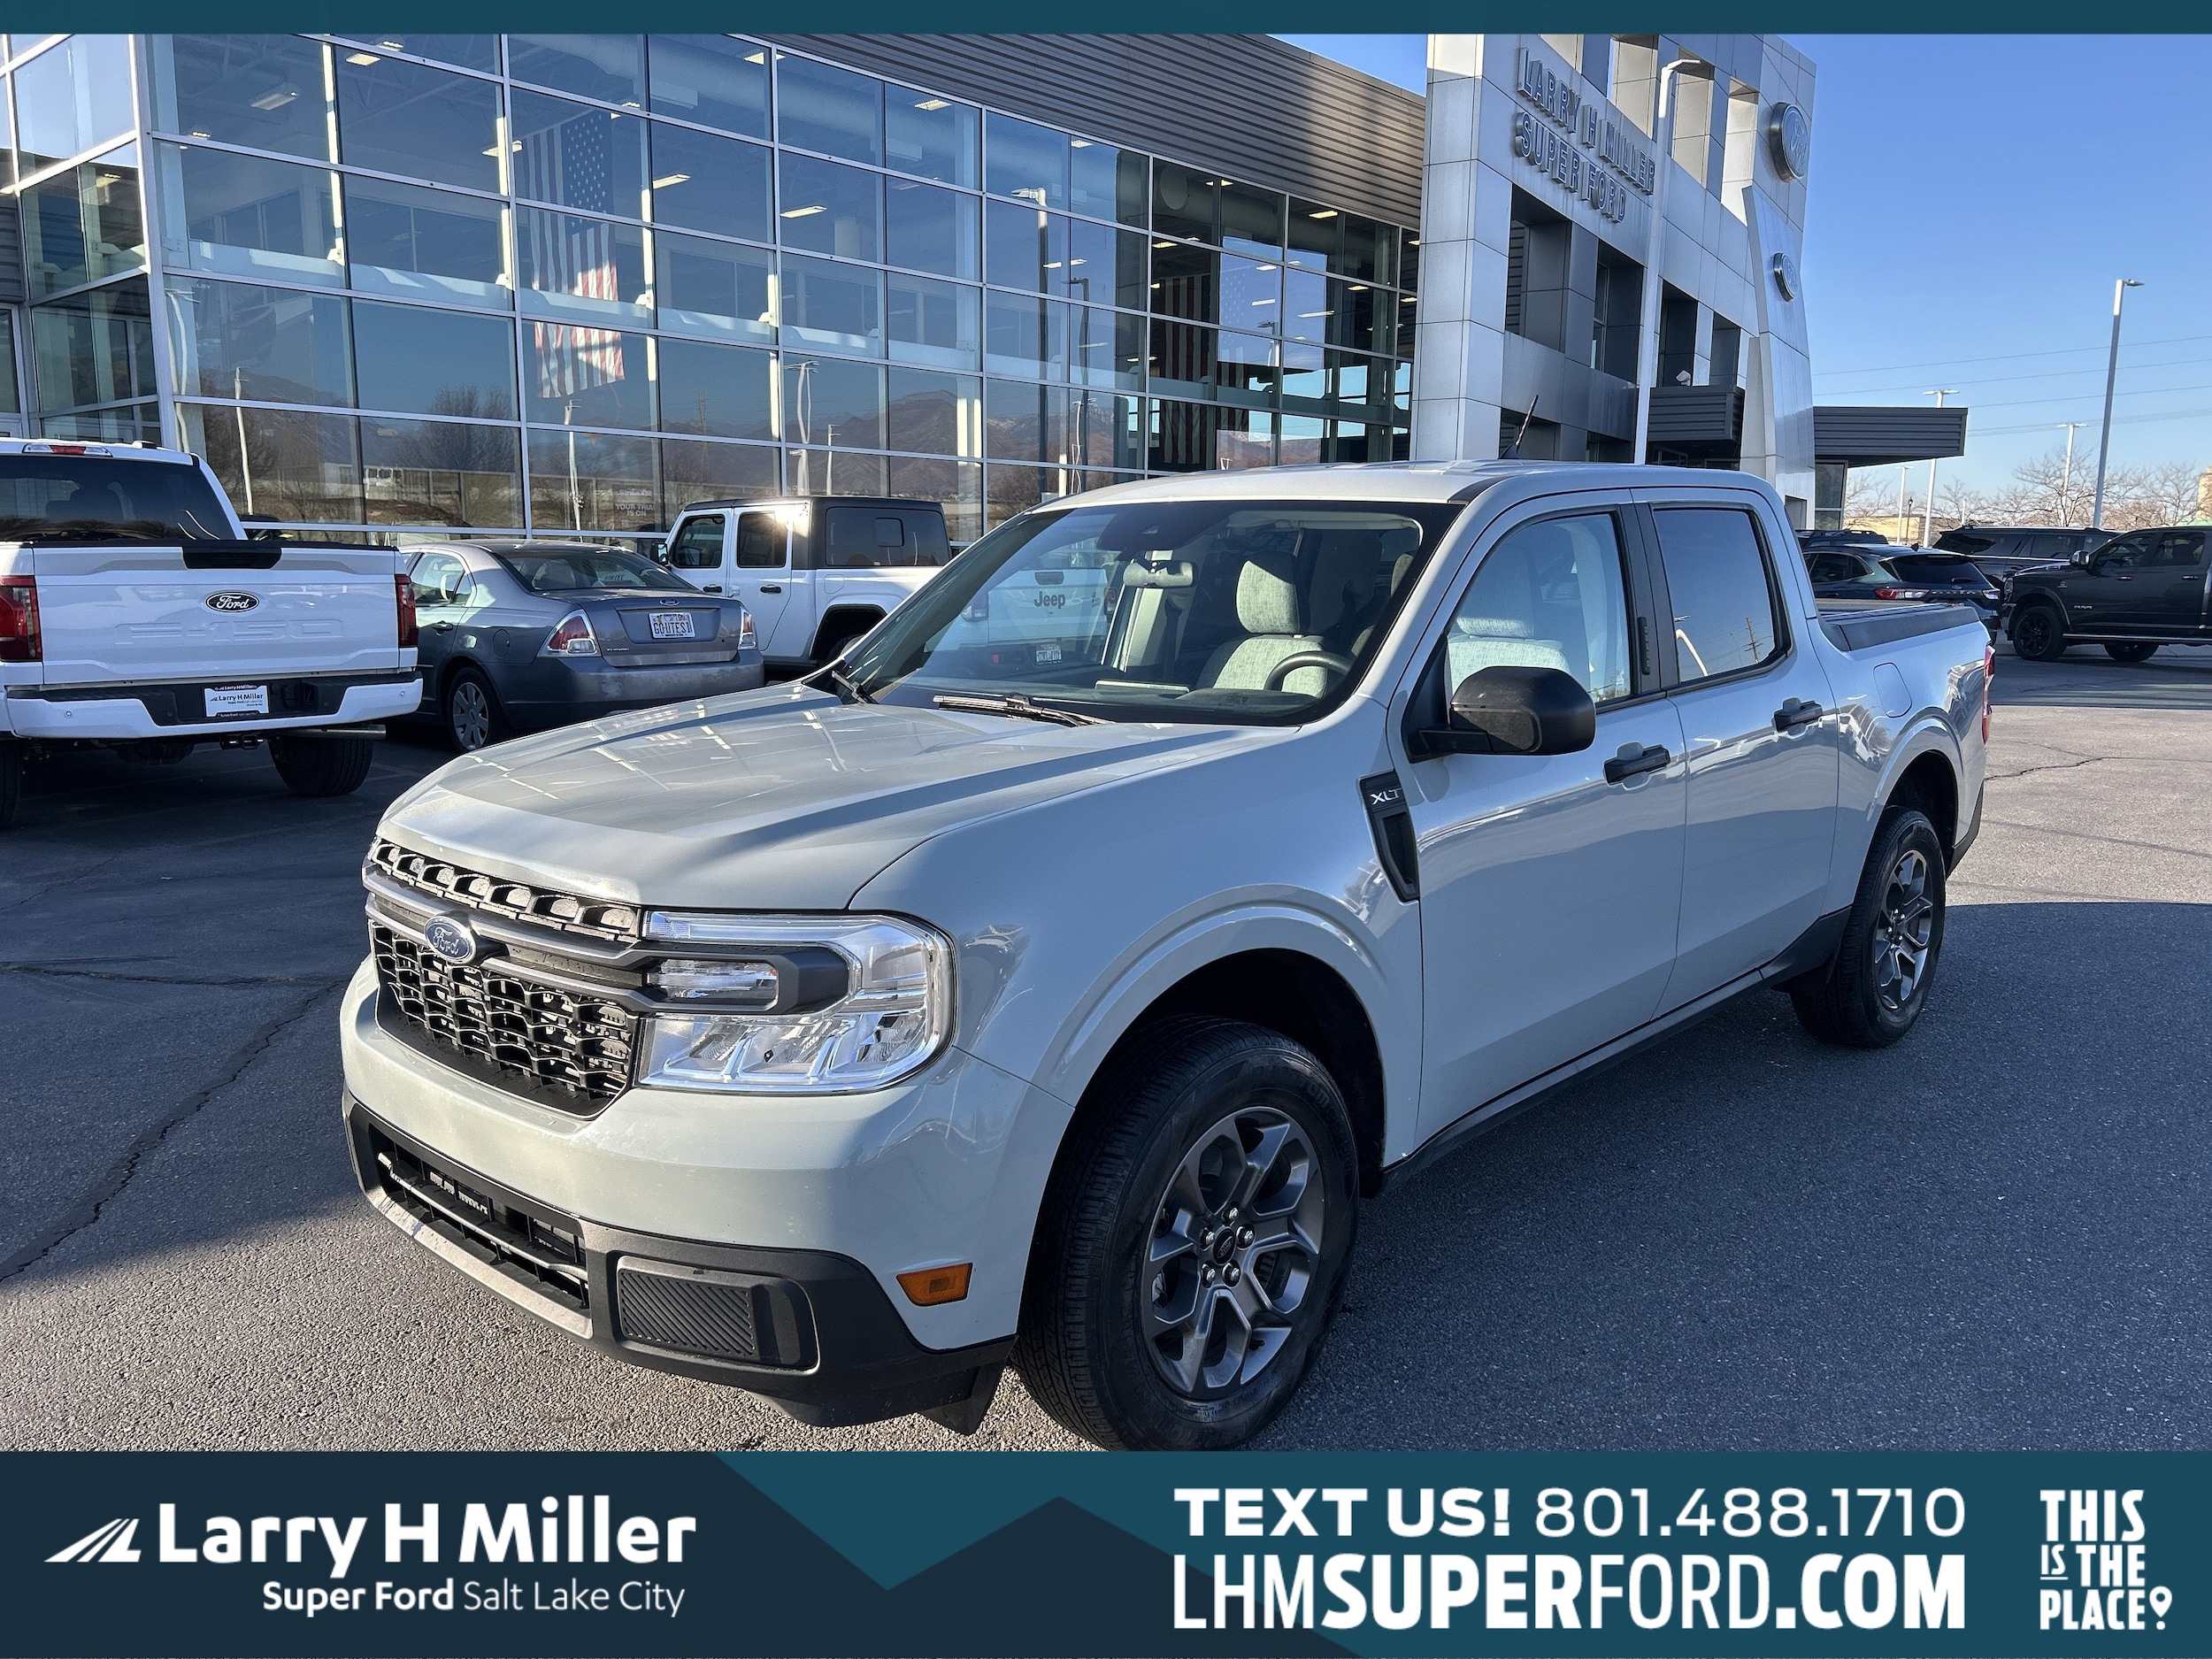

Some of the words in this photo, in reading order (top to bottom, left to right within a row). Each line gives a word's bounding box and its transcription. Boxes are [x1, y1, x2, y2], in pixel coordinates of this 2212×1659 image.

[1517, 47, 1581, 134] LARRY
[1582, 104, 1598, 149] H
[1599, 119, 1655, 196] MILLER
[1515, 111, 1581, 193] SUPER
[1581, 161, 1626, 223] FORD
[216, 595, 250, 609] Ford
[1033, 591, 1066, 609] Jeep
[1370, 787, 1402, 805] XLT
